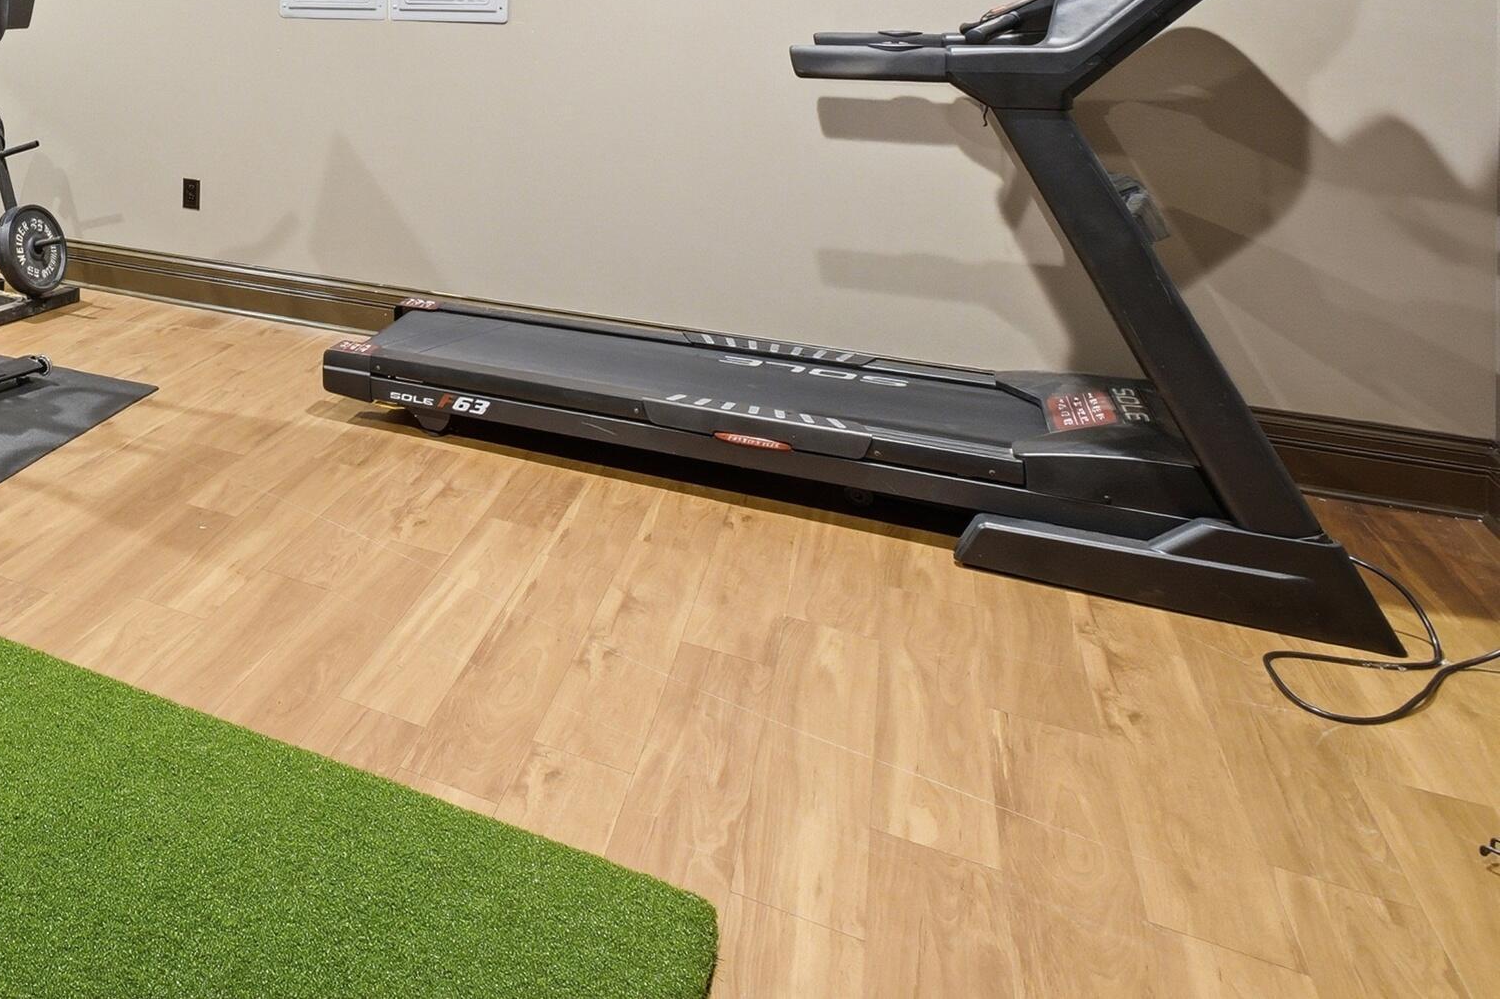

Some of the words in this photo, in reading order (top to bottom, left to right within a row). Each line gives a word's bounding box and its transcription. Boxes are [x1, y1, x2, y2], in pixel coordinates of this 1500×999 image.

[15, 220, 30, 266] WEIDER
[719, 355, 910, 388] SOLE
[389, 391, 435, 406] SOLE
[437, 392, 491, 415] F63
[1112, 387, 1150, 422] SOLE
